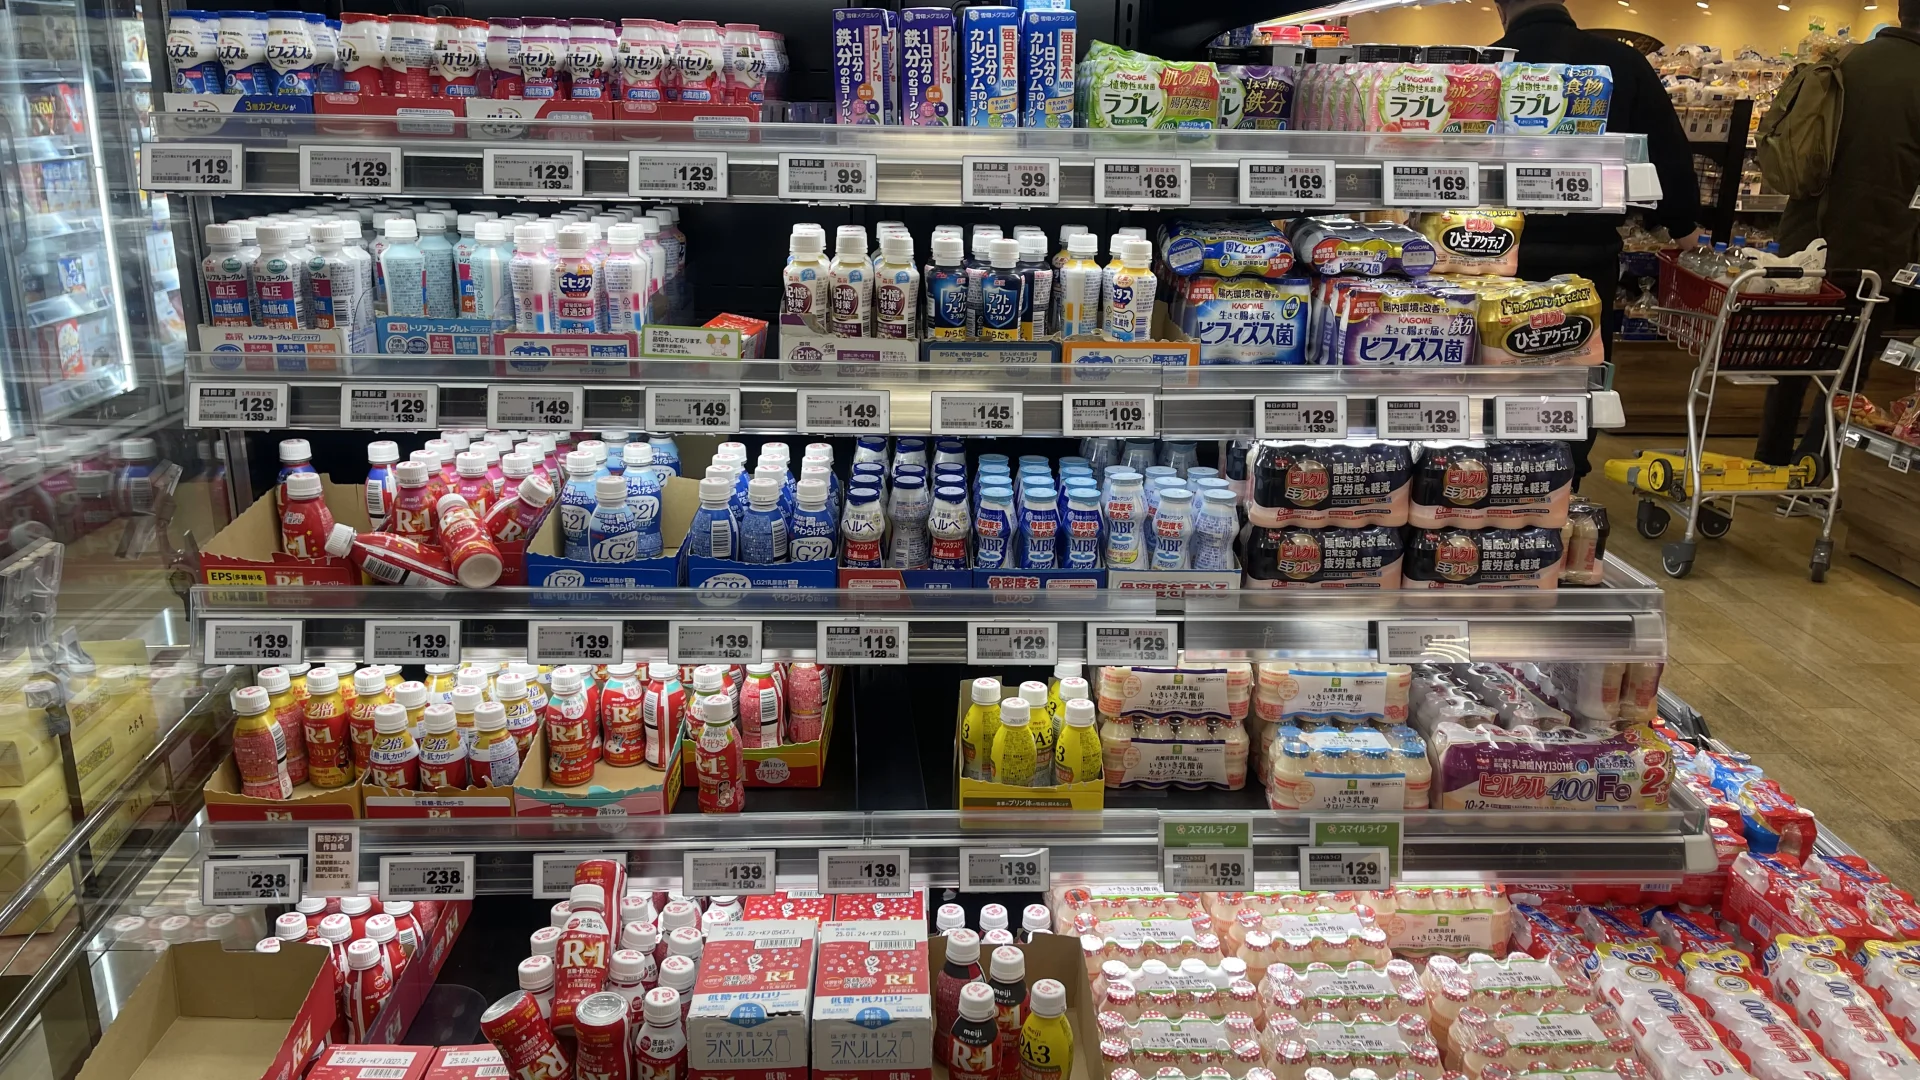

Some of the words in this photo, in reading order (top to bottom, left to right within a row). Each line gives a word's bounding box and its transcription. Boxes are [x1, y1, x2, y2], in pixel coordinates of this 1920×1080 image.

[915, 12, 950, 20] 雪印メグミルク
[852, 28, 864, 82] 1日分の
[871, 28, 882, 82] プルーンFe
[921, 29, 932, 84] 1日分の
[940, 29, 952, 84] プルーンFe
[985, 28, 998, 85] 1日分の
[1002, 28, 1016, 78] 毎日骨太
[1044, 31, 1056, 86] 1日分の
[1060, 31, 1074, 80] 毎日骨太
[1001, 80, 1017, 88] MBP
[1404, 75, 1434, 83] KAGOME
[1566, 78, 1604, 96] 食物
[1104, 93, 1159, 114] ラブレ
[1244, 90, 1286, 114] 鉄分
[1390, 95, 1446, 118] ラブレ
[1510, 94, 1560, 116] ラブレ
[1570, 97, 1608, 116] 繊維
[192, 160, 227, 173] 119
[352, 162, 387, 176] 129
[534, 165, 569, 179] 129
[679, 167, 713, 180] 129
[838, 170, 862, 183] 99
[1021, 173, 1045, 187] 99
[1144, 175, 1177, 188] 169
[1289, 175, 1322, 189] 169
[1433, 176, 1465, 190] 169
[1556, 178, 1588, 192] 169
[1465, 218, 1495, 233] ピルクル
[1450, 232, 1508, 250] ひざアクティブ
[559, 276, 592, 288] ビヒダス
[215, 284, 237, 296] 血圧
[262, 285, 282, 297] 血圧
[785, 288, 808, 300] 記憶
[832, 288, 855, 300] 記憶
[878, 288, 902, 300] 記憶
[988, 292, 1010, 302] ラクト
[986, 304, 1012, 315] フェリン
[1231, 302, 1264, 310] KAGOME
[1219, 310, 1276, 320] 生きて腸まで届く
[1398, 316, 1432, 324] KAGOME
[1529, 310, 1565, 329] ピルクル
[1200, 322, 1295, 346] ビフィズス菌
[1385, 324, 1445, 336] 生きて腸まで届く
[1514, 323, 1582, 348] ひざアクティブ
[1360, 336, 1464, 362] ビフィズス菌
[240, 398, 274, 411] 129
[391, 399, 424, 413] 129
[536, 401, 569, 414] 149
[693, 403, 726, 416] 149
[844, 405, 876, 418] 149
[978, 406, 1009, 419] 145
[1110, 408, 1141, 421] 109
[1302, 410, 1334, 423] 129
[1425, 410, 1456, 423] 129
[1541, 411, 1573, 424] 328
[1288, 471, 1327, 485] ピルクル
[1333, 474, 1366, 484] 日常生活の
[1448, 470, 1486, 484] ピルクル
[1492, 474, 1526, 482] 日常生活の
[1285, 487, 1328, 500] ミラクルケア
[1332, 482, 1391, 496] 疲労感を軽減
[1444, 486, 1488, 499] ミラクルケア
[1491, 482, 1550, 495] 疲労感を軽減
[396, 509, 434, 533] R-1
[1110, 522, 1134, 534] MBP
[1029, 540, 1056, 551] MBP
[1070, 540, 1096, 551] MBP
[1158, 540, 1182, 552] MBP
[1440, 546, 1476, 560] ピルクル
[1435, 562, 1477, 574] ミラクルケア
[1482, 558, 1540, 570] 疲労感を軽減
[254, 635, 287, 648] 139
[413, 635, 446, 648] 139
[575, 635, 608, 648] 139
[715, 635, 748, 648] 139
[864, 635, 895, 648] 119
[1014, 636, 1045, 649] 129
[1133, 637, 1164, 651] 129
[1150, 691, 1204, 700] いきいき乳酸菌
[1307, 693, 1362, 701] いきいき乳酸菌
[309, 702, 336, 718] 2倍
[564, 707, 584, 718] 鉄分
[304, 726, 335, 744] R-1
[550, 724, 584, 742] R-1
[380, 738, 403, 750] 2倍
[1149, 762, 1204, 770] いきいき乳酸菌
[373, 770, 408, 786] R-1
[1479, 773, 1547, 800] ピルクル
[1546, 778, 1595, 800] 400
[1596, 772, 1632, 802] Fe
[1322, 796, 1380, 804] いきいき乳酸菌
[1187, 824, 1237, 834] スマイルライフ
[1338, 824, 1388, 834] スマイルライフ
[730, 866, 761, 879] 139
[865, 864, 896, 877] 139
[1005, 862, 1036, 875] 139
[1210, 863, 1241, 876] 159
[1346, 862, 1377, 875] 129
[252, 874, 285, 888] 238
[427, 871, 460, 884] 238
[1411, 933, 1471, 942] いきいき乳酸菌
[560, 940, 606, 969] R-1
[766, 970, 795, 982] R-1
[884, 974, 915, 986] R-1
[964, 1028, 982, 1037] meiji
[706, 1039, 774, 1058] ラベルレス
[832, 1040, 898, 1059] ラベルレス
[954, 1040, 996, 1072] R-1
